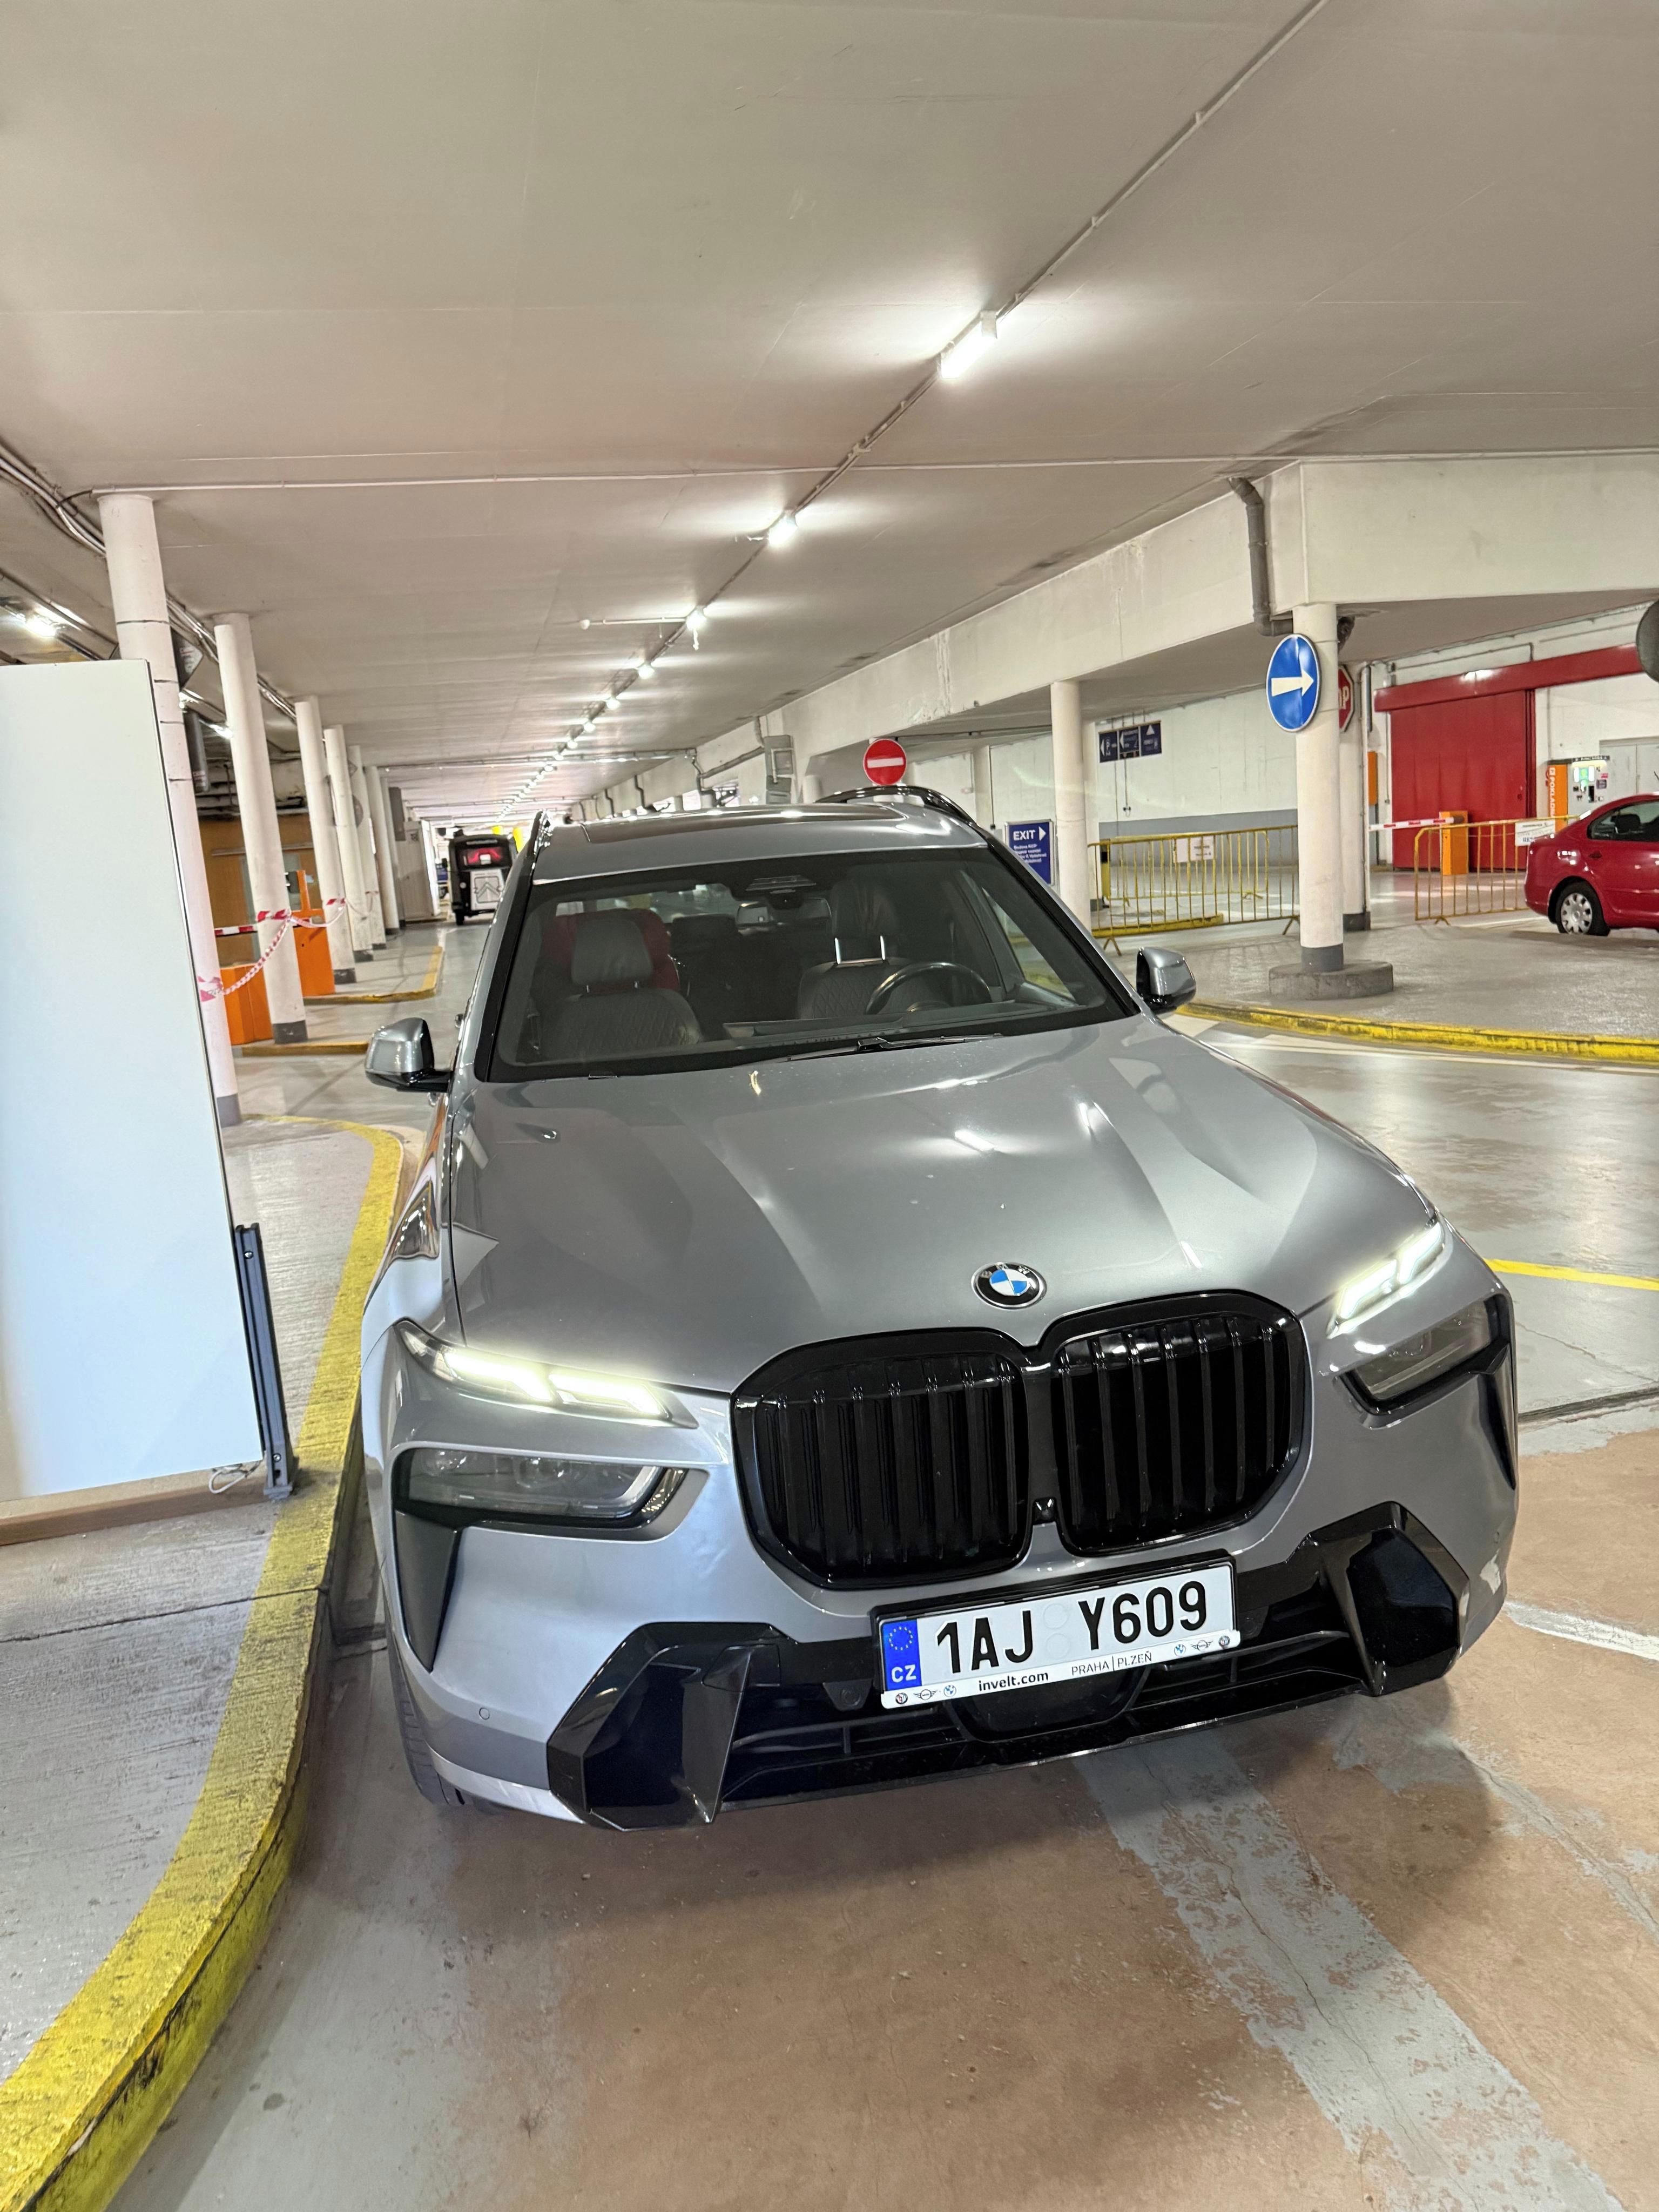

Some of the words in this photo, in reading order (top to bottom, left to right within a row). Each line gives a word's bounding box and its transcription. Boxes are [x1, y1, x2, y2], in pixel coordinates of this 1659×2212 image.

[1013, 830, 1036, 841] EXIT
[936, 1609, 1033, 1674] 1AJ
[1078, 1580, 1206, 1650] Y609
[891, 1664, 917, 1683] CZ
[979, 1672, 1049, 1692] invelt.com
[1071, 1660, 1110, 1676] PRAHA
